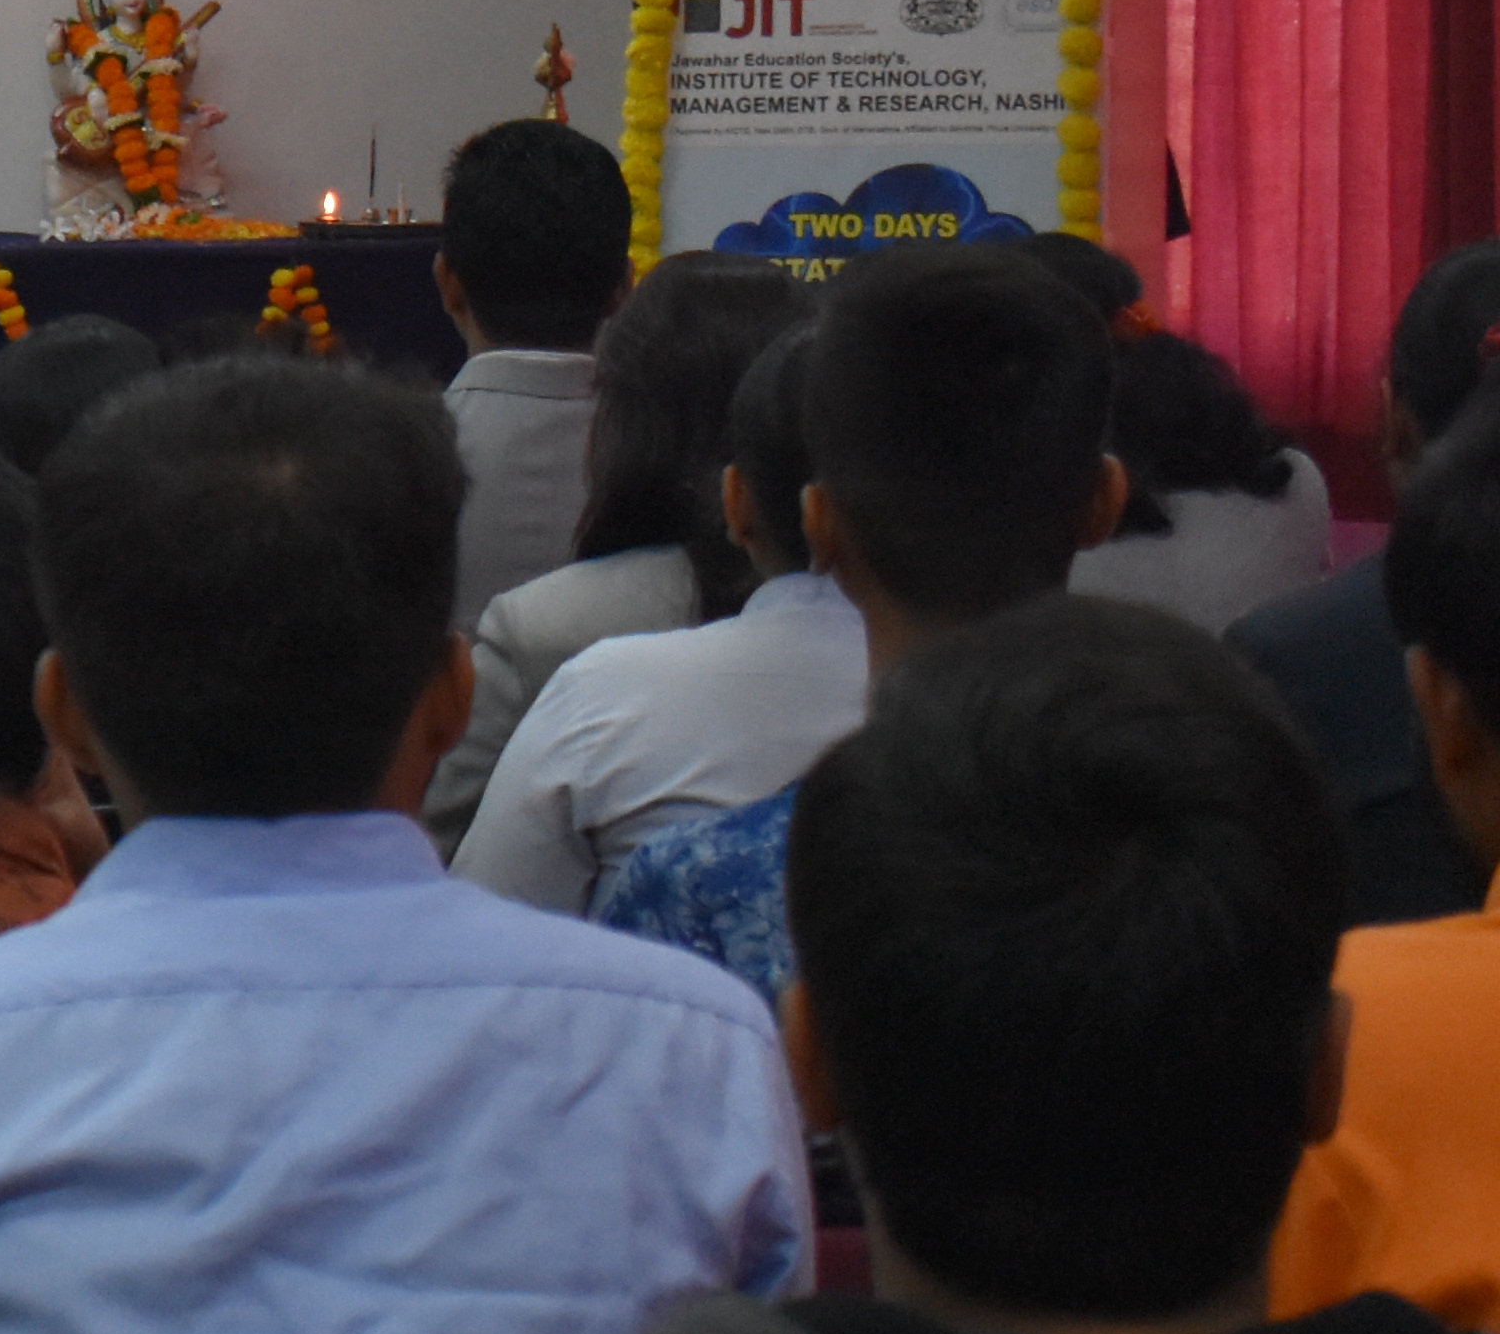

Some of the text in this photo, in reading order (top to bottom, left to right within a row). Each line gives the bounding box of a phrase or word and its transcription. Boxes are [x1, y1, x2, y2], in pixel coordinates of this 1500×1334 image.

[671, 52, 739, 68] Jawahar
[744, 50, 826, 67] Education
[670, 68, 987, 90] INSTITUTE OF TECHNOLOGY,
[669, 92, 1066, 115] MANAGEMENT & RESEARCH, NASHI
[789, 213, 958, 238] TWO DAYS
